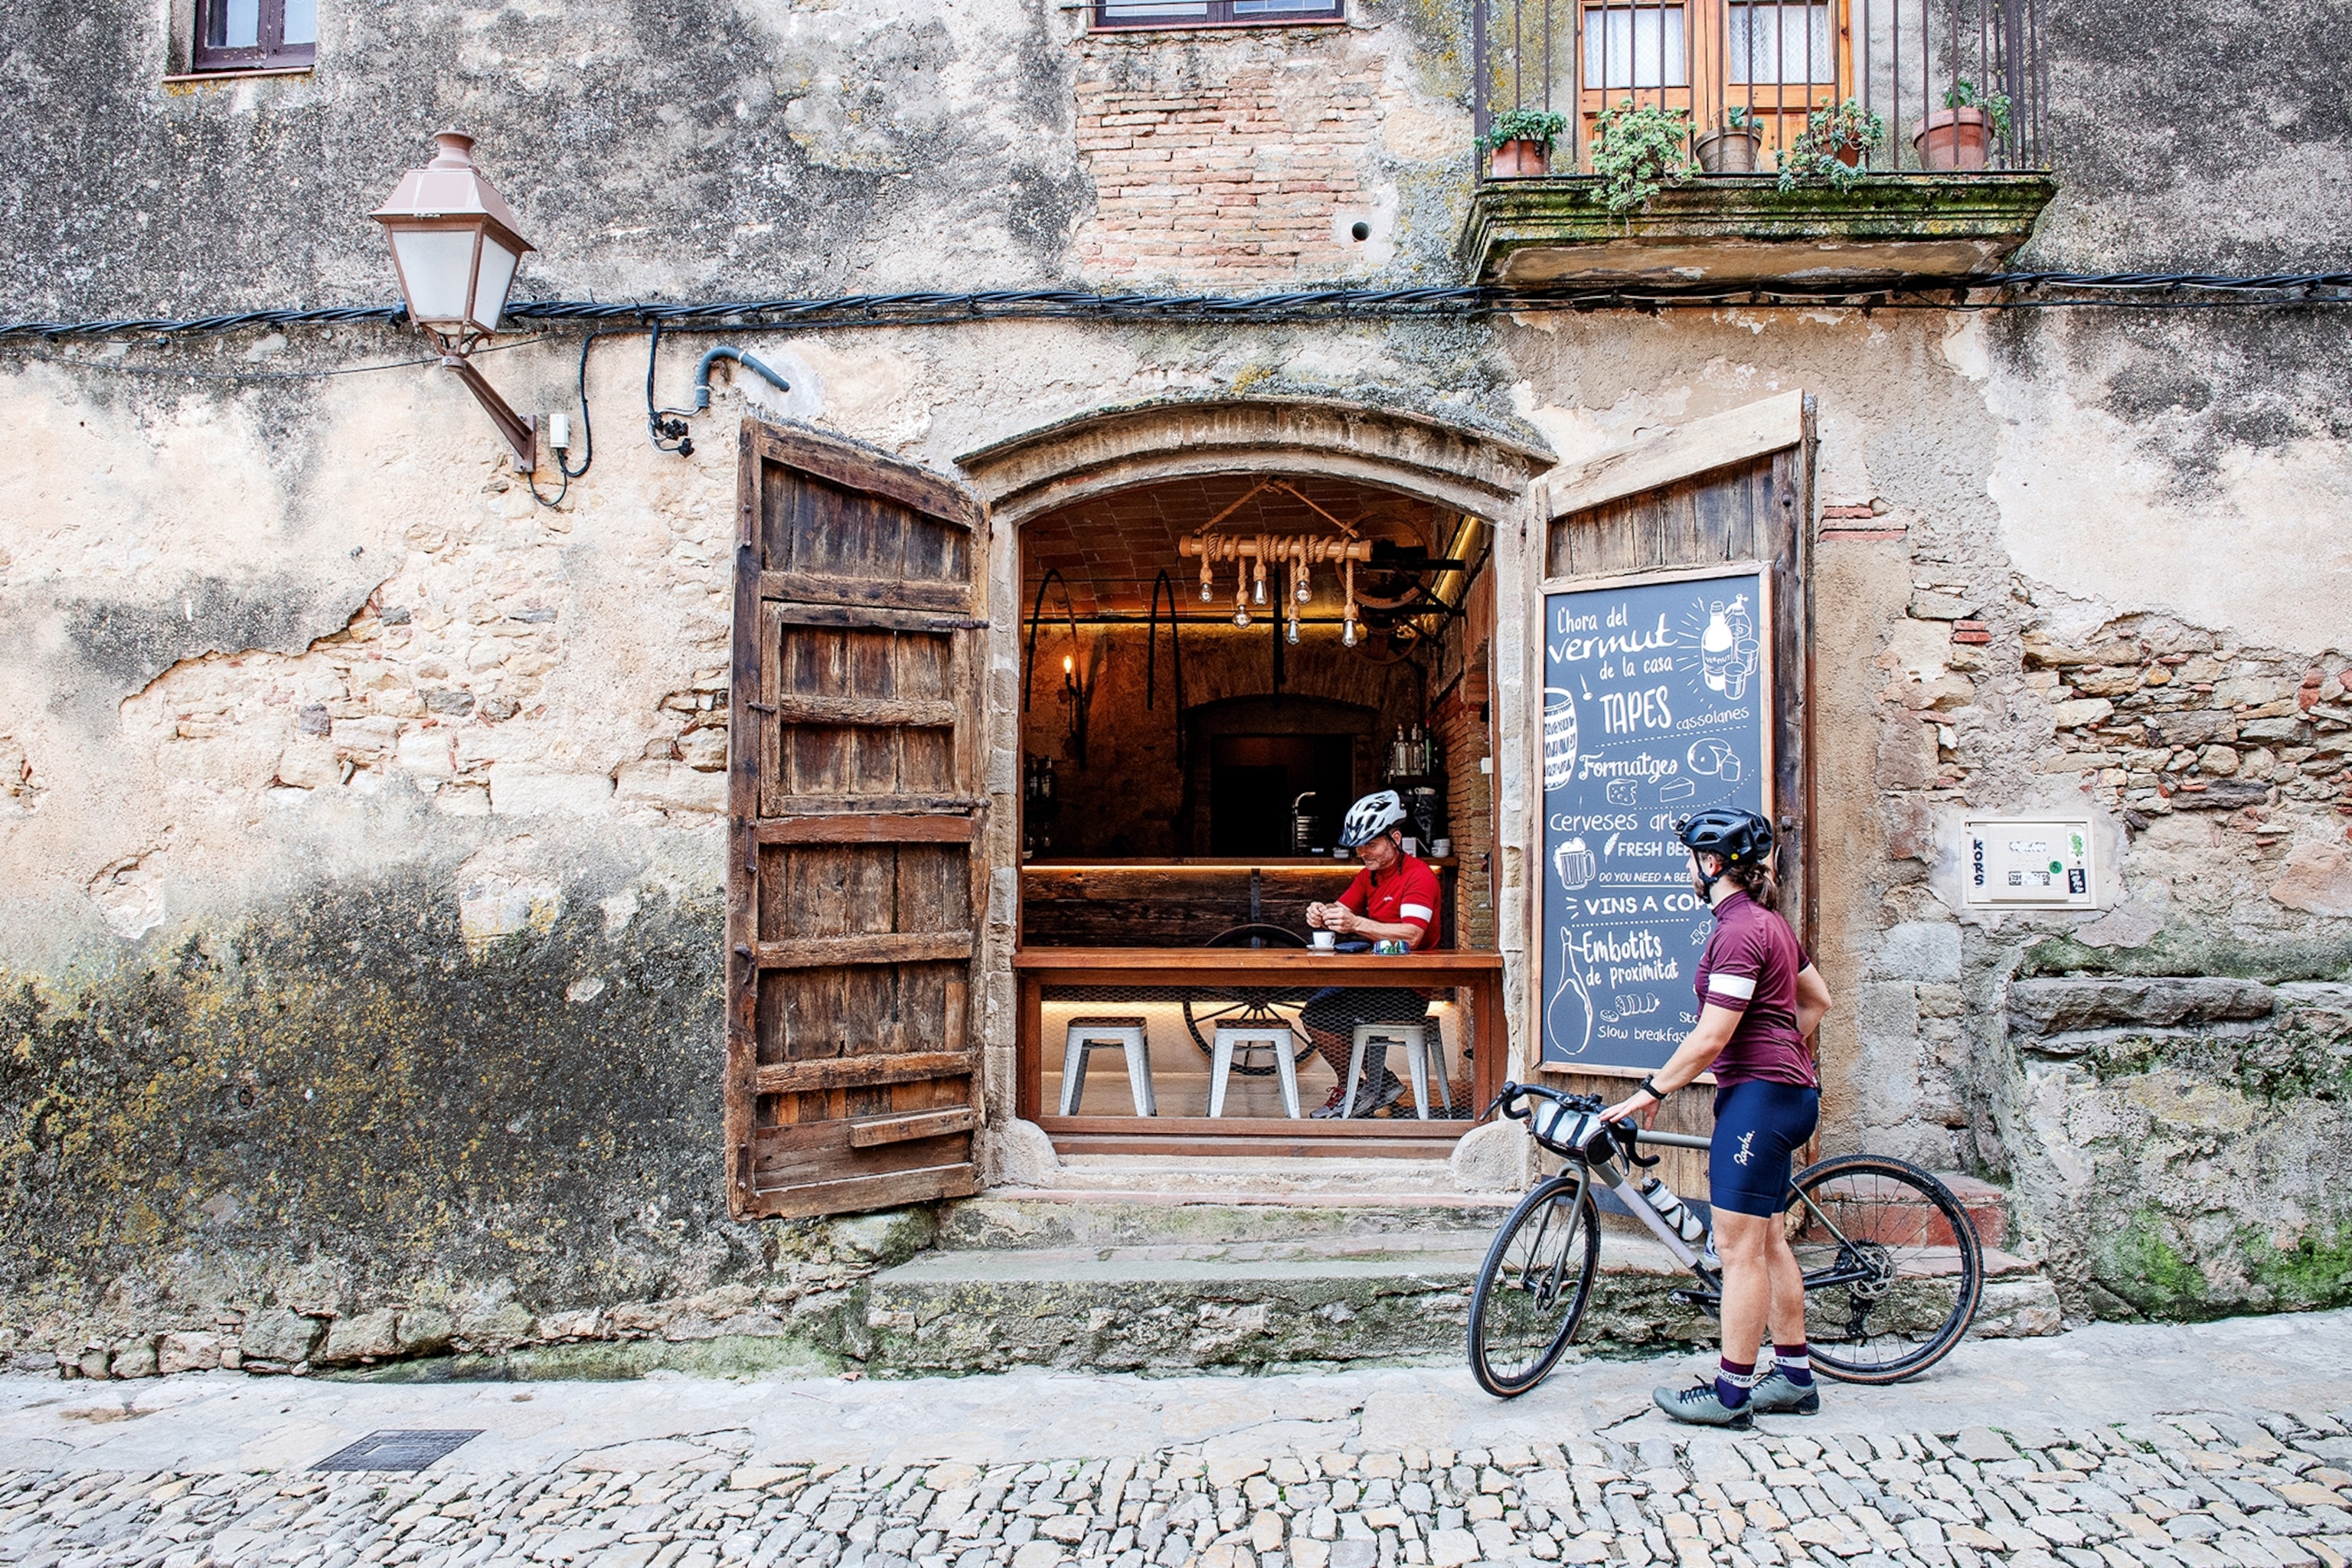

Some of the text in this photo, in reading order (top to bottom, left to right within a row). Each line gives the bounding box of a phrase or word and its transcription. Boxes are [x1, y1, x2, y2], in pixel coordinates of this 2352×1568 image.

[1606, 603, 1628, 628] del
[1548, 612, 1678, 664] vermut
[1599, 656, 1673, 680] de la casa
[1599, 685, 1749, 733] TAPES cassolanes
[1579, 752, 1678, 784] Formatges
[1650, 812, 1697, 832] arte
[1619, 841, 1662, 857] FRESH
[1599, 873, 1612, 881] DO
[1615, 873, 1632, 882] YOU
[1635, 873, 1661, 882] NEED
[1664, 873, 1671, 882] A
[1585, 894, 1713, 915] VINS A COP
[1583, 929, 1662, 962] Embotits
[1586, 957, 1678, 988] de proximitat
[1598, 1025, 1690, 1043] Slow breakfas
